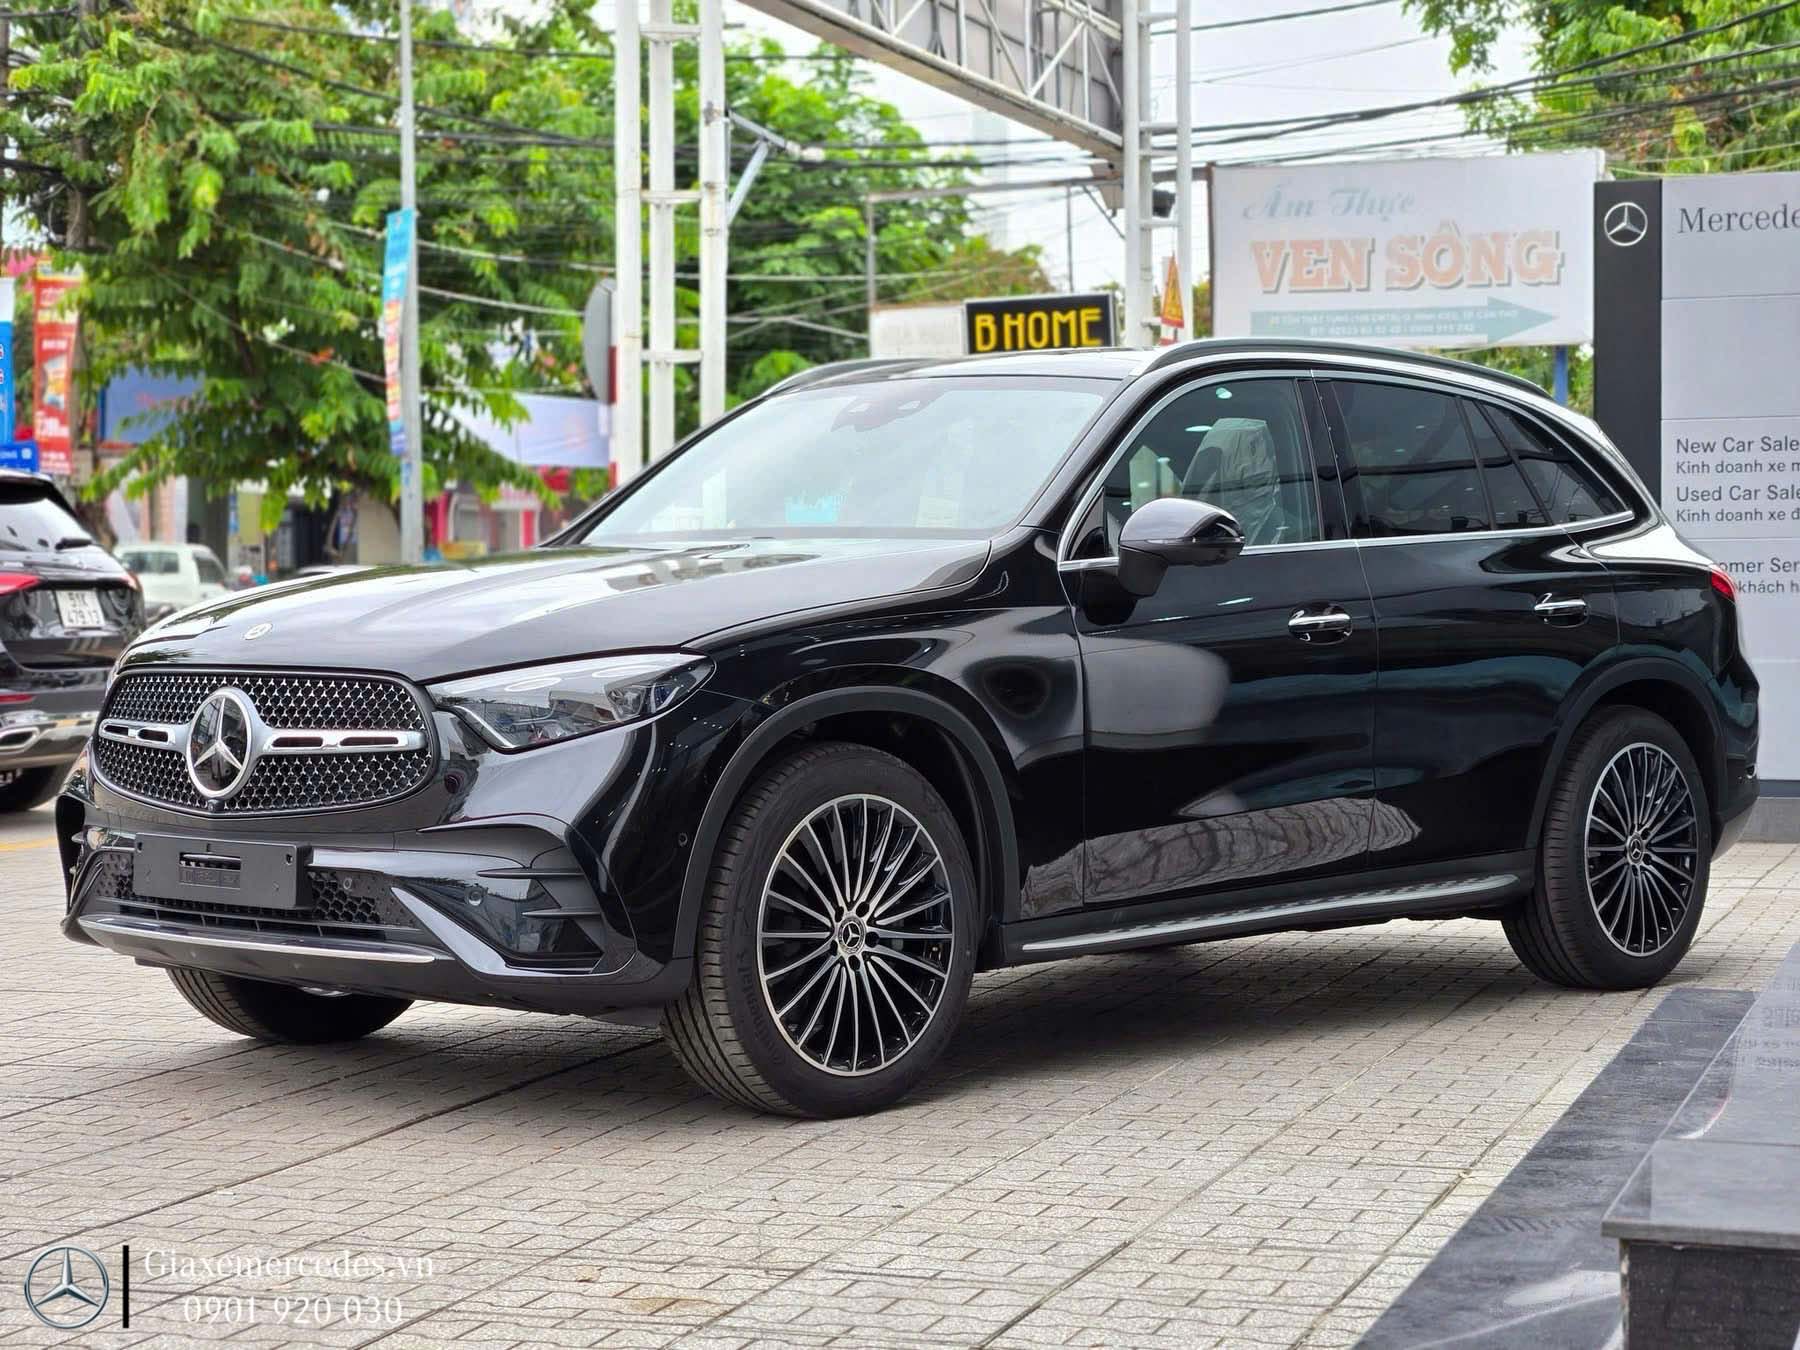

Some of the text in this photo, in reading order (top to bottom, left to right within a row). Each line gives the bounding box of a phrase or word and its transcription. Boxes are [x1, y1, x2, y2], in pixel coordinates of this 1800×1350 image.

[1678, 203, 1800, 233] Mercede
[1250, 219, 1564, 293] VEN SÔNG
[974, 308, 1103, 352] B HOME
[1676, 435, 1800, 453] New Car Sale
[1676, 460, 1710, 474] Kinh
[1715, 460, 1763, 474] doanh
[1768, 462, 1786, 472] xe
[1676, 486, 1722, 501] Used
[1729, 486, 1761, 501] Car
[1676, 508, 1710, 522] Kinh
[1715, 508, 1763, 521] doanh
[1768, 511, 1786, 520] xe
[1718, 557, 1800, 573] omer Ser
[1738, 580, 1785, 593] khách
